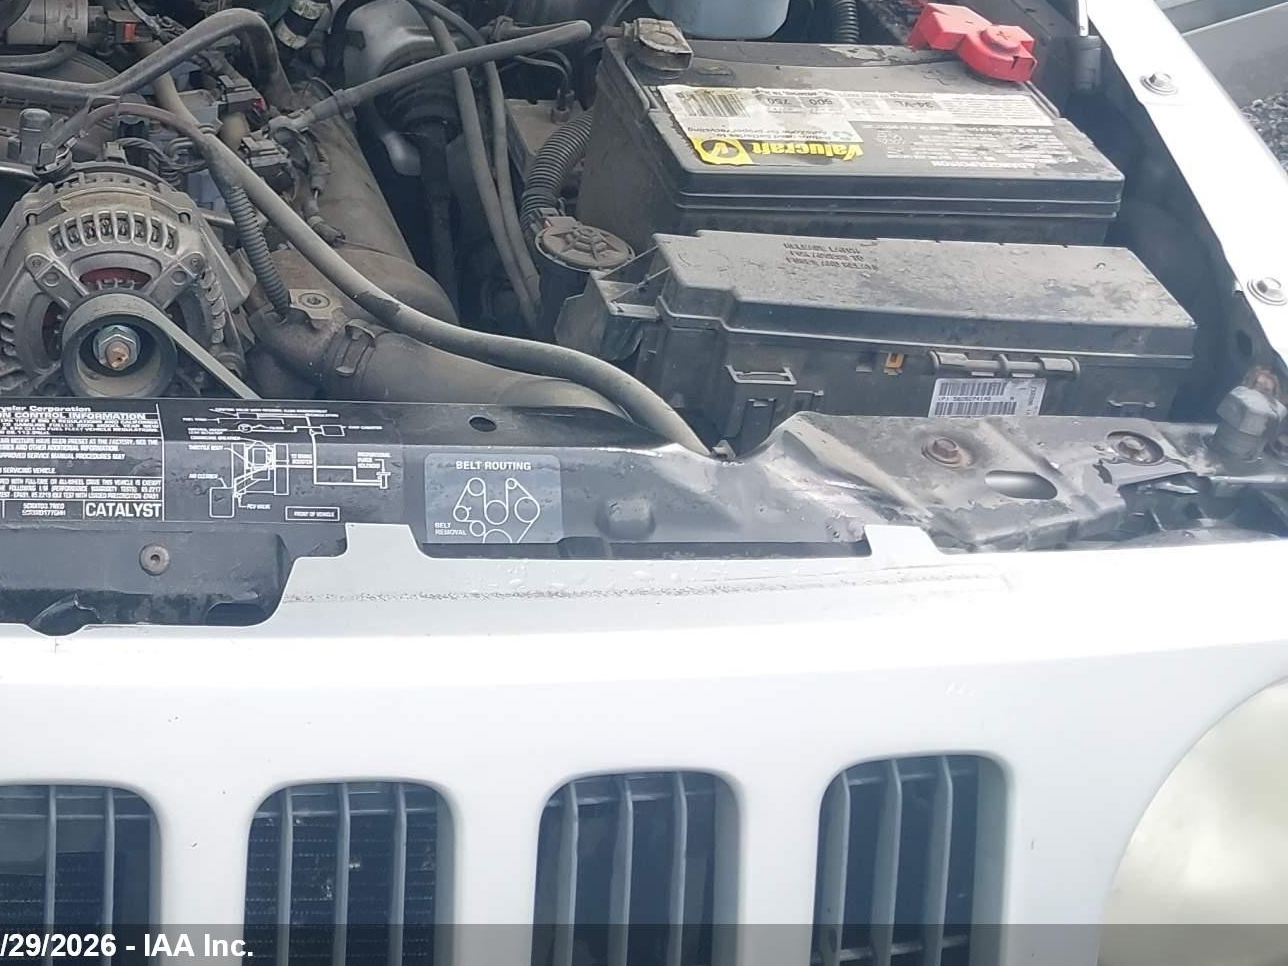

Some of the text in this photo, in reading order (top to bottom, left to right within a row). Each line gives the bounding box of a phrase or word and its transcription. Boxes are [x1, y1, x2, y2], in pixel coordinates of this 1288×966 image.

[752, 141, 864, 161] Valucraft
[14, 412, 64, 420] CONTROL
[68, 412, 147, 421] INFORMATION
[455, 460, 532, 471] BELT ROUTING
[85, 502, 162, 518] CATALYST
